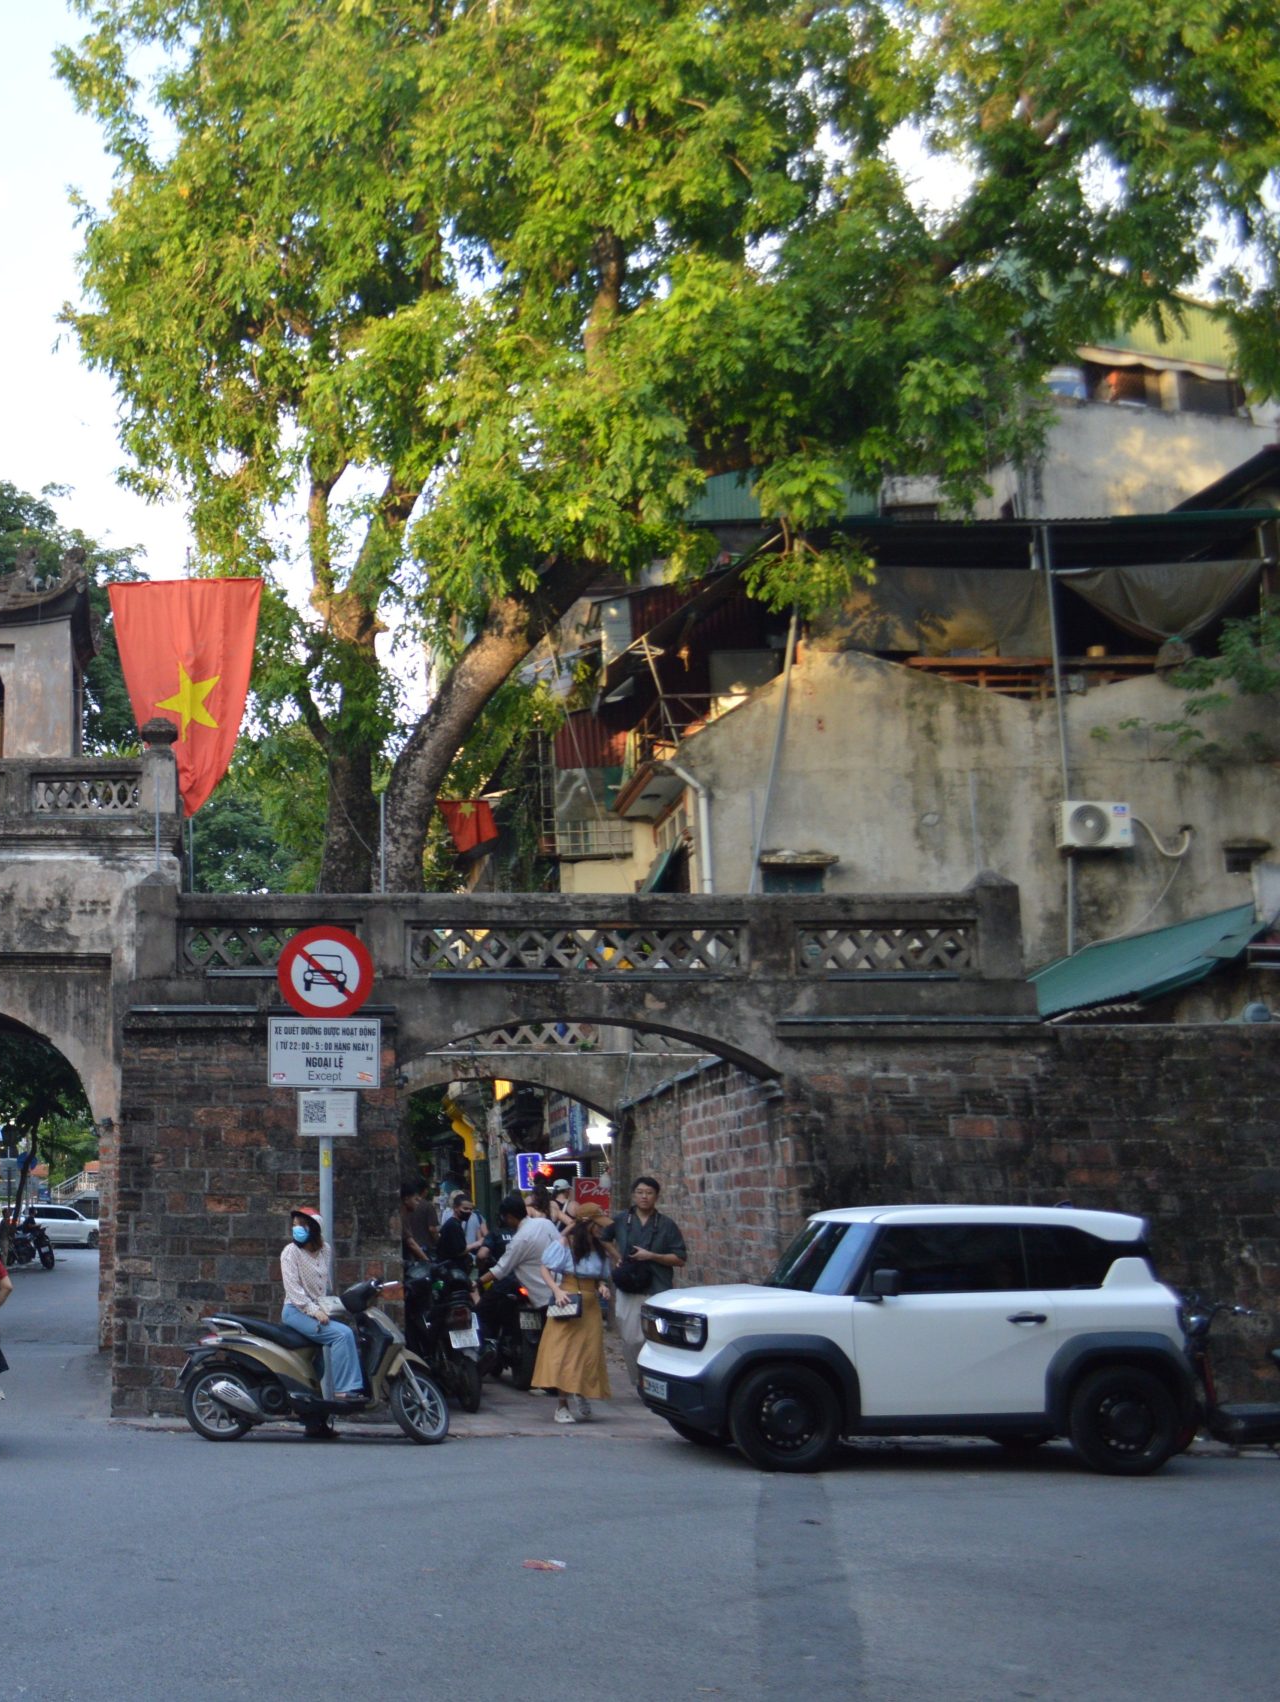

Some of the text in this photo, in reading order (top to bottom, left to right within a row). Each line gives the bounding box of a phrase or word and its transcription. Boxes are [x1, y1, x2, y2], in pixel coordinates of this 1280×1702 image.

[274, 1026, 282, 1035] XE
[305, 1054, 344, 1070] NGOẠI LỆ
[308, 1070, 342, 1083] Except
